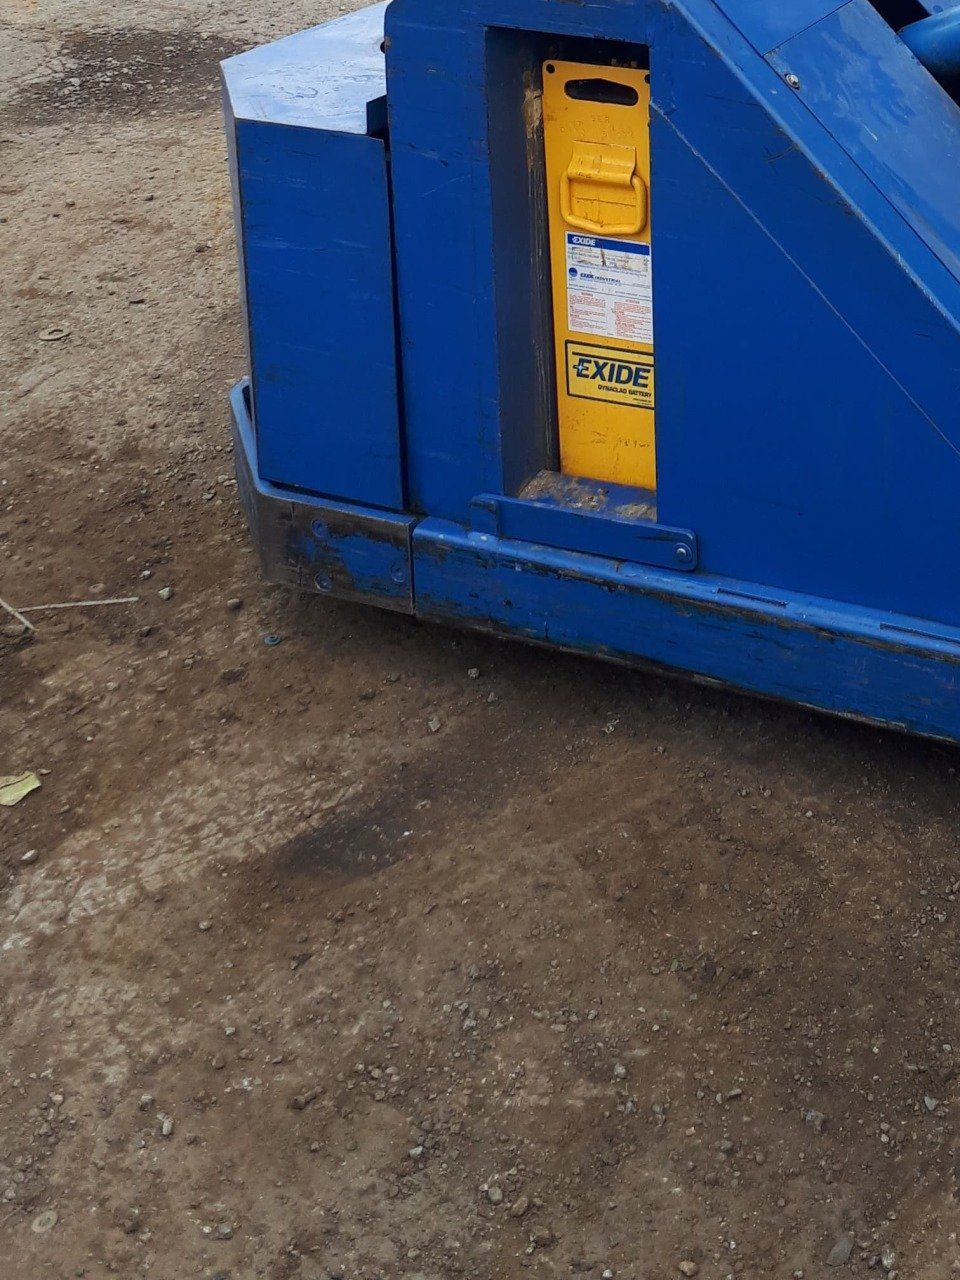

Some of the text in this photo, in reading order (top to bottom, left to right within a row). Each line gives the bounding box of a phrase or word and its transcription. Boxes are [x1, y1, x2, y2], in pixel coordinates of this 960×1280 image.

[572, 236, 597, 246] EXIDE
[573, 357, 651, 389] EXIDE
[628, 389, 652, 398] BATTERY
